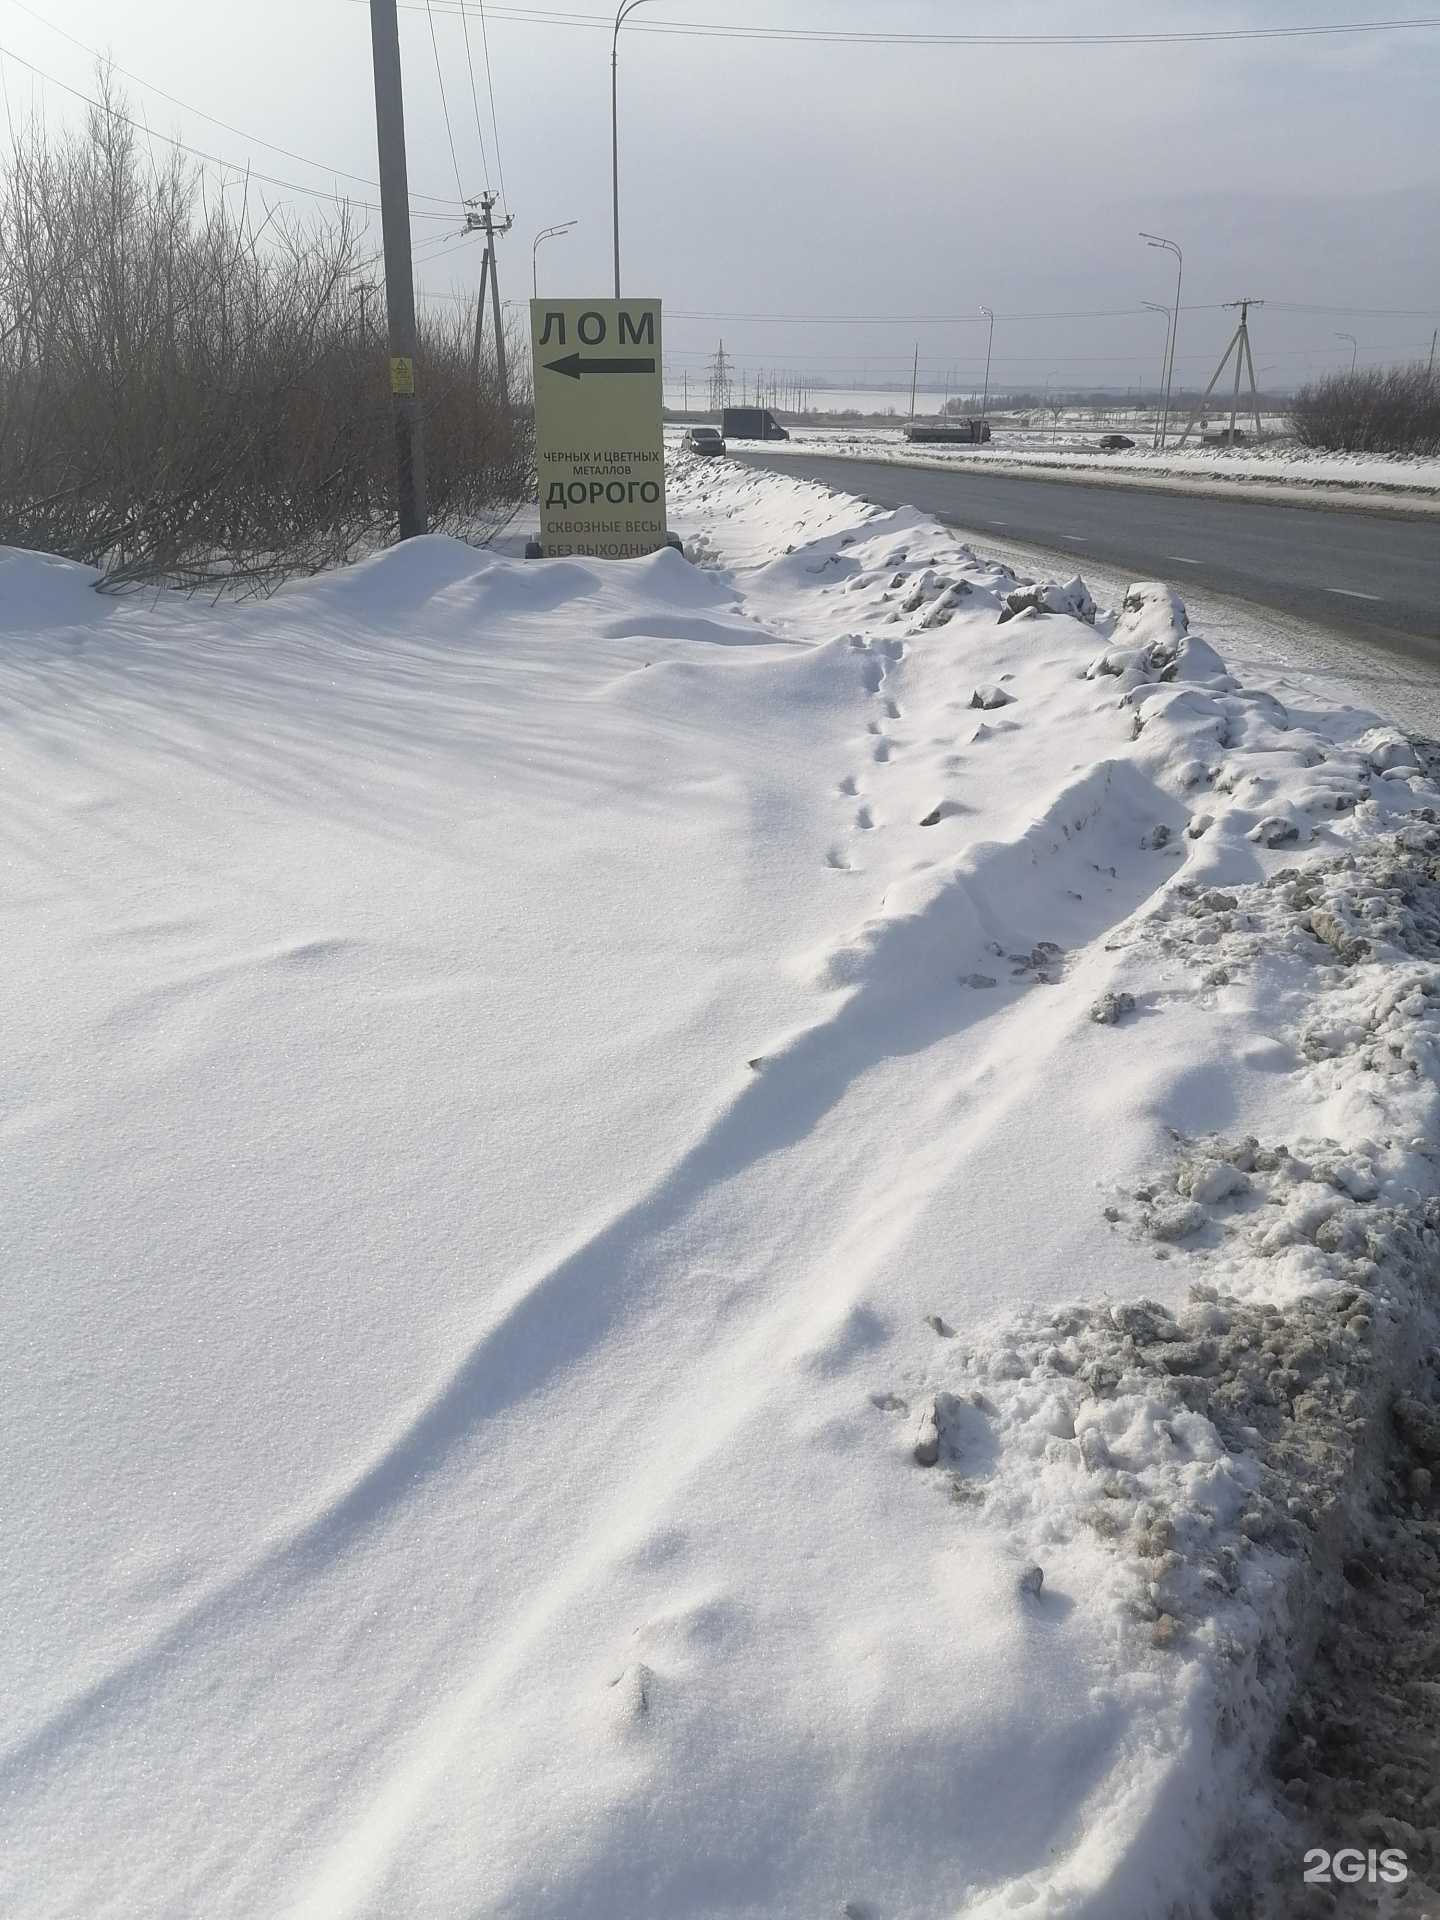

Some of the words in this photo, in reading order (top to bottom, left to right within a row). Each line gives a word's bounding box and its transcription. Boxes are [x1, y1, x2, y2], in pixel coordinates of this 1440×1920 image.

[539, 311, 655, 346] ЛОМ
[543, 451, 591, 463] ЧЕРНЫХ
[593, 452, 602, 462] И
[604, 451, 660, 464] ЦВЕТНЫХ
[572, 465, 632, 476] МЕТАЛЛОВ
[545, 480, 661, 510] ДОРОГО
[546, 521, 623, 534] СКВОЗНЫЕ
[625, 520, 662, 533] ВЕСЫ
[547, 544, 577, 556] БЕЗ
